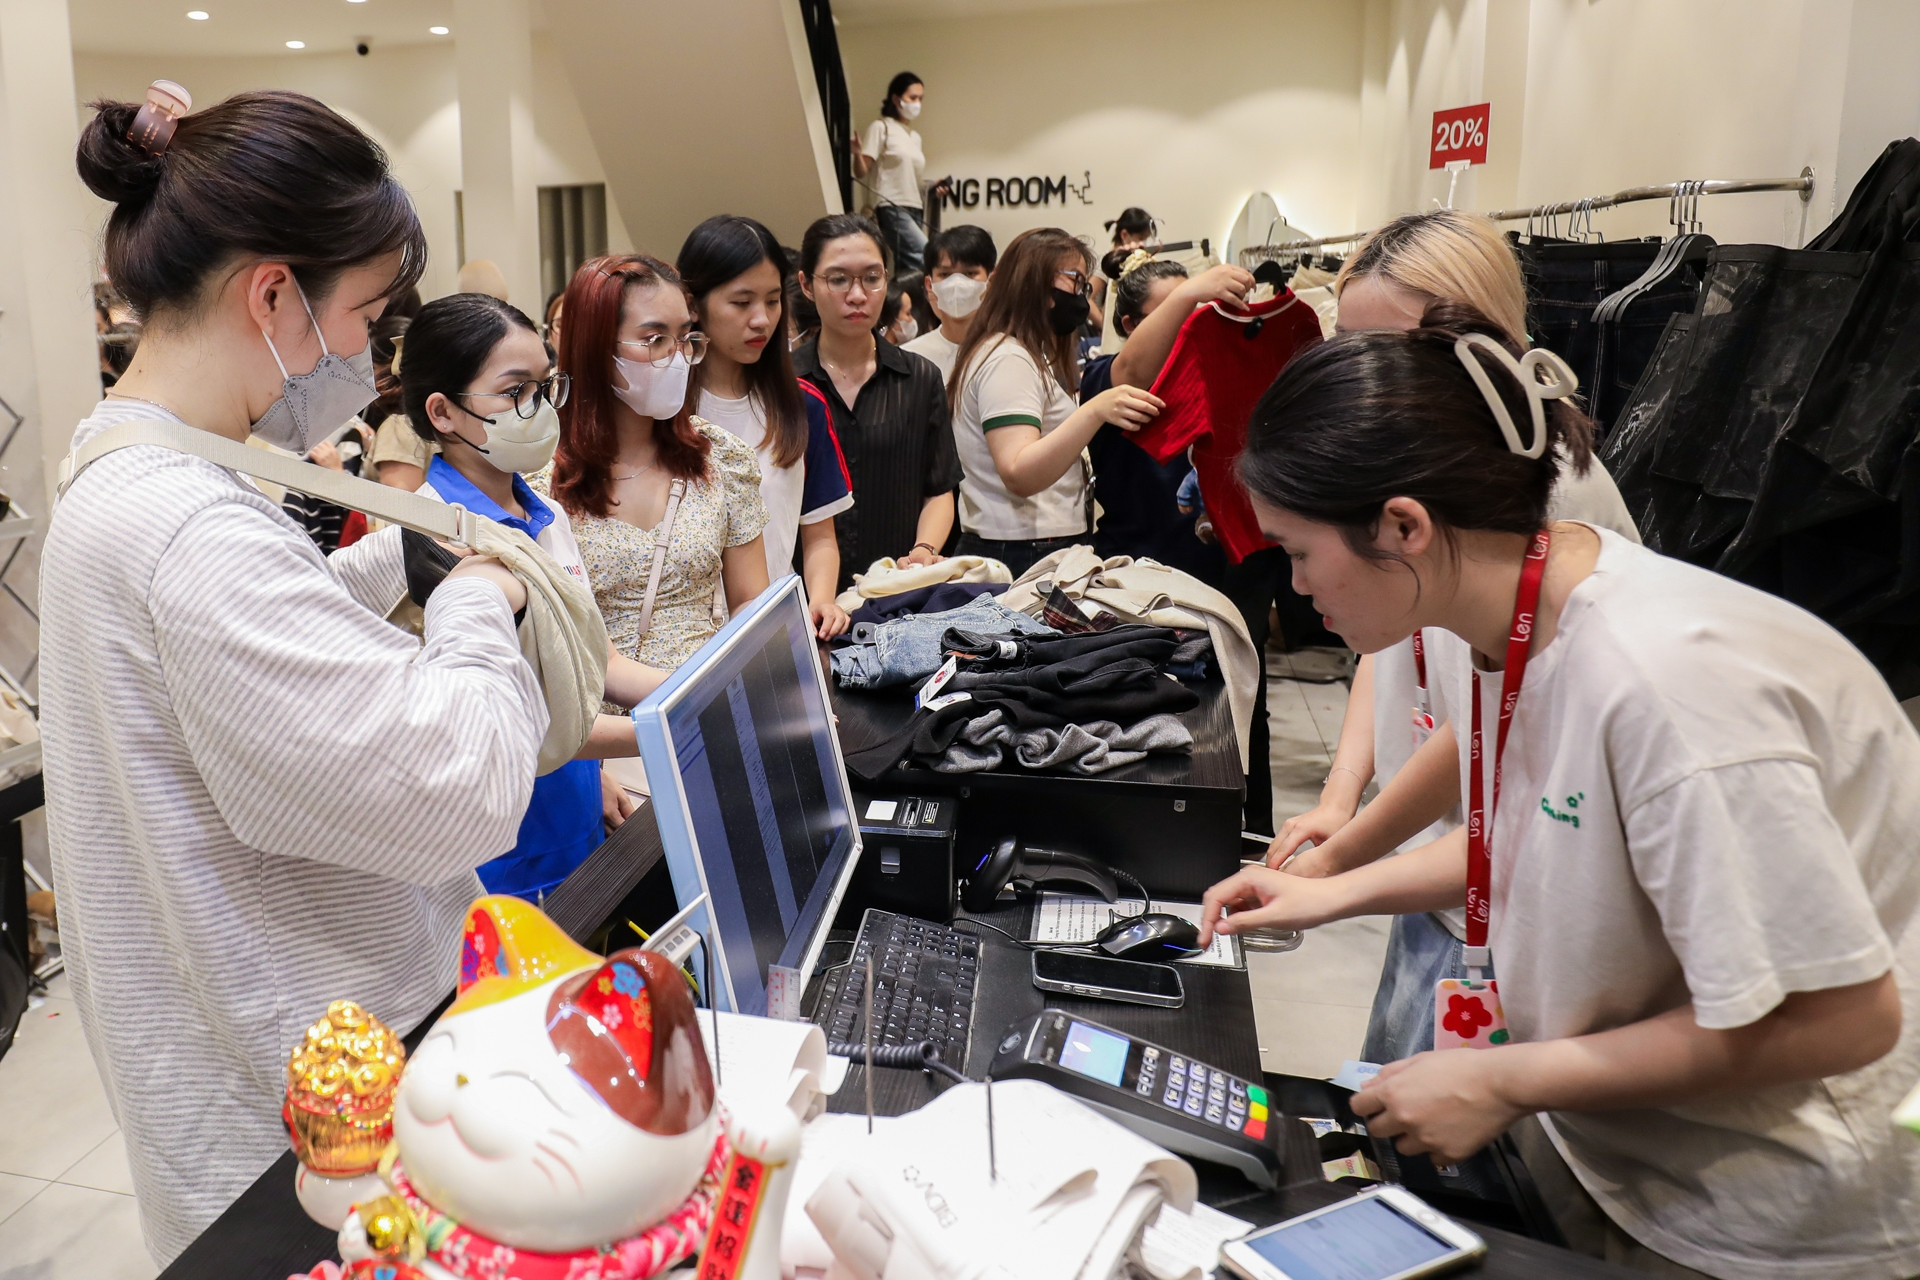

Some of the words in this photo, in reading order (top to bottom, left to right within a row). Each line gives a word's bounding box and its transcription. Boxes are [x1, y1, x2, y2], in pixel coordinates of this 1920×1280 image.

[1435, 117, 1484, 151] 20%
[986, 175, 1066, 207] ROOM
[1526, 534, 1549, 559] Len
[1509, 613, 1533, 642] Len
[1500, 692, 1518, 719] Len
[1471, 731, 1482, 760] Len
[1470, 809, 1483, 837] Len
[1472, 899, 1489, 924] Len
